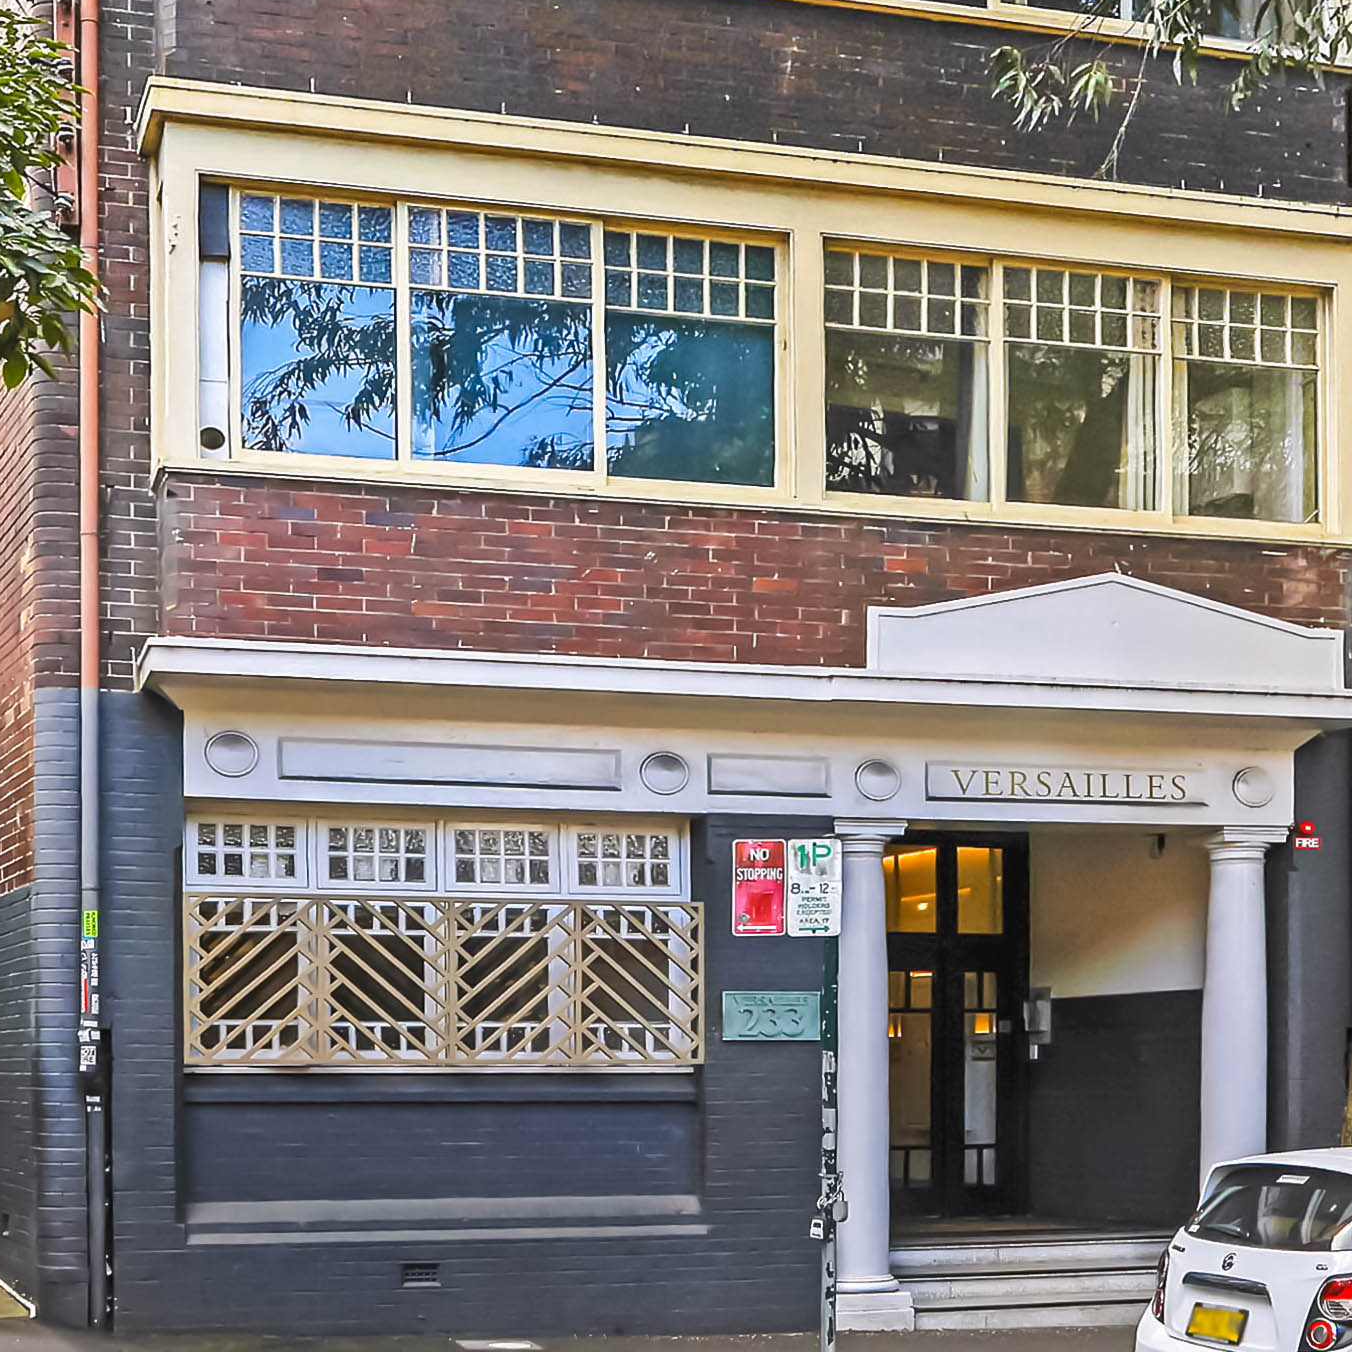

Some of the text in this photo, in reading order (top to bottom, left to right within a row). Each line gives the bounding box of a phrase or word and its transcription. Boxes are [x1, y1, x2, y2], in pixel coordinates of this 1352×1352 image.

[951, 769, 1187, 800] VERSAILLES
[1296, 837, 1319, 848] FIRE
[750, 848, 769, 861] NO
[797, 844, 831, 867] 1P
[736, 868, 783, 881] STOPPING
[736, 1007, 806, 1038] 233
